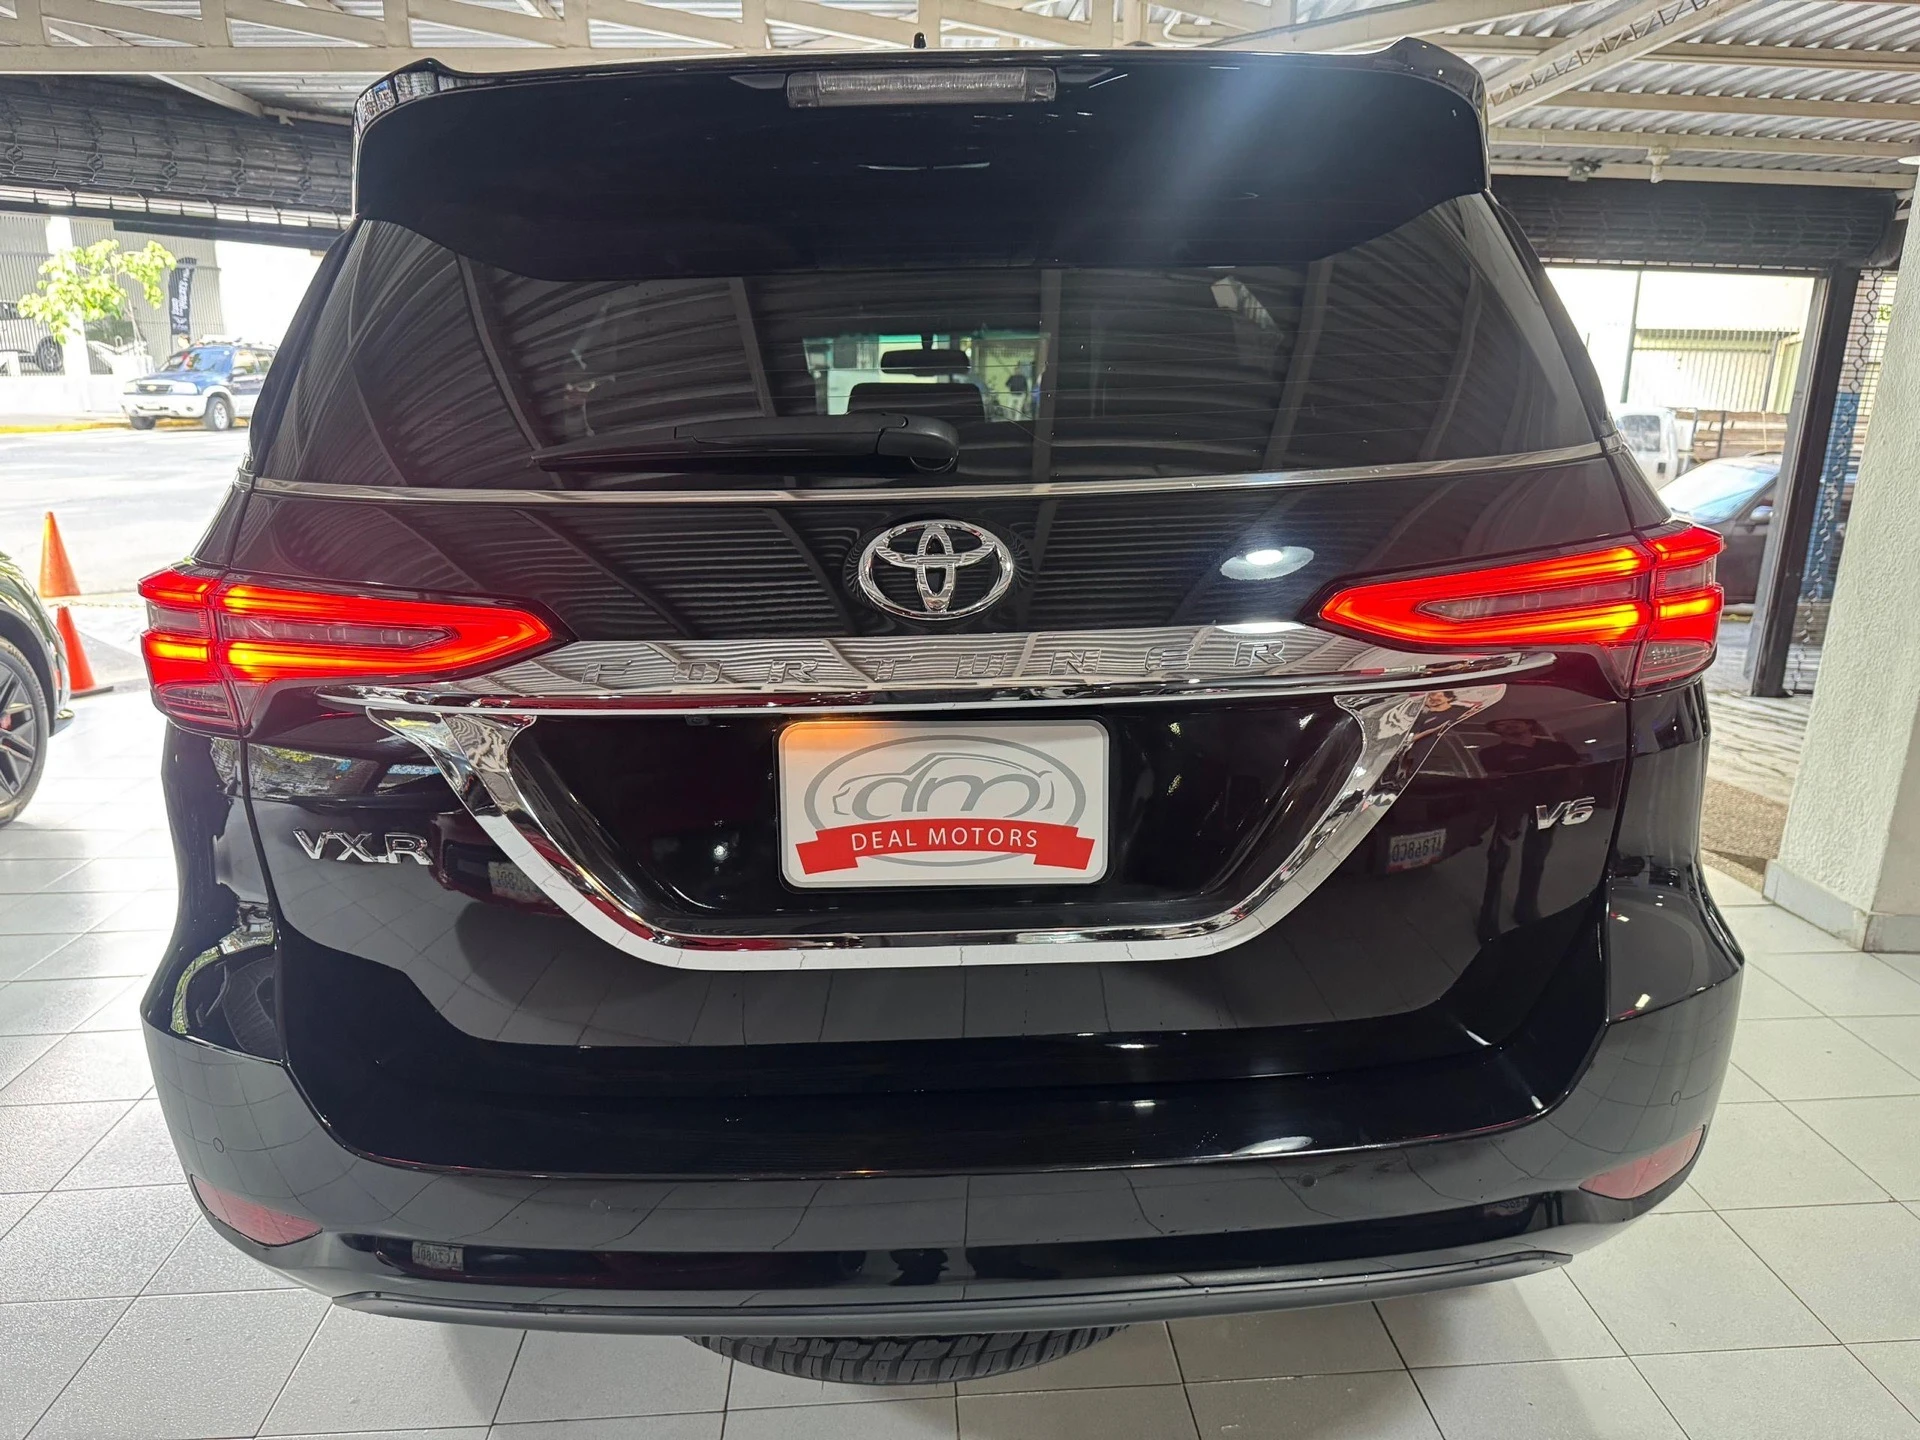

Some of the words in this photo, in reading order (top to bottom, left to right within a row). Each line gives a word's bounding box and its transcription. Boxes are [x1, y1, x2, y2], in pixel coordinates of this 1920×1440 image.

[580, 640, 1287, 684] FORTUNER
[1535, 797, 1596, 830] V6
[851, 829, 917, 851] DEAL
[928, 828, 1038, 847] MOTORS
